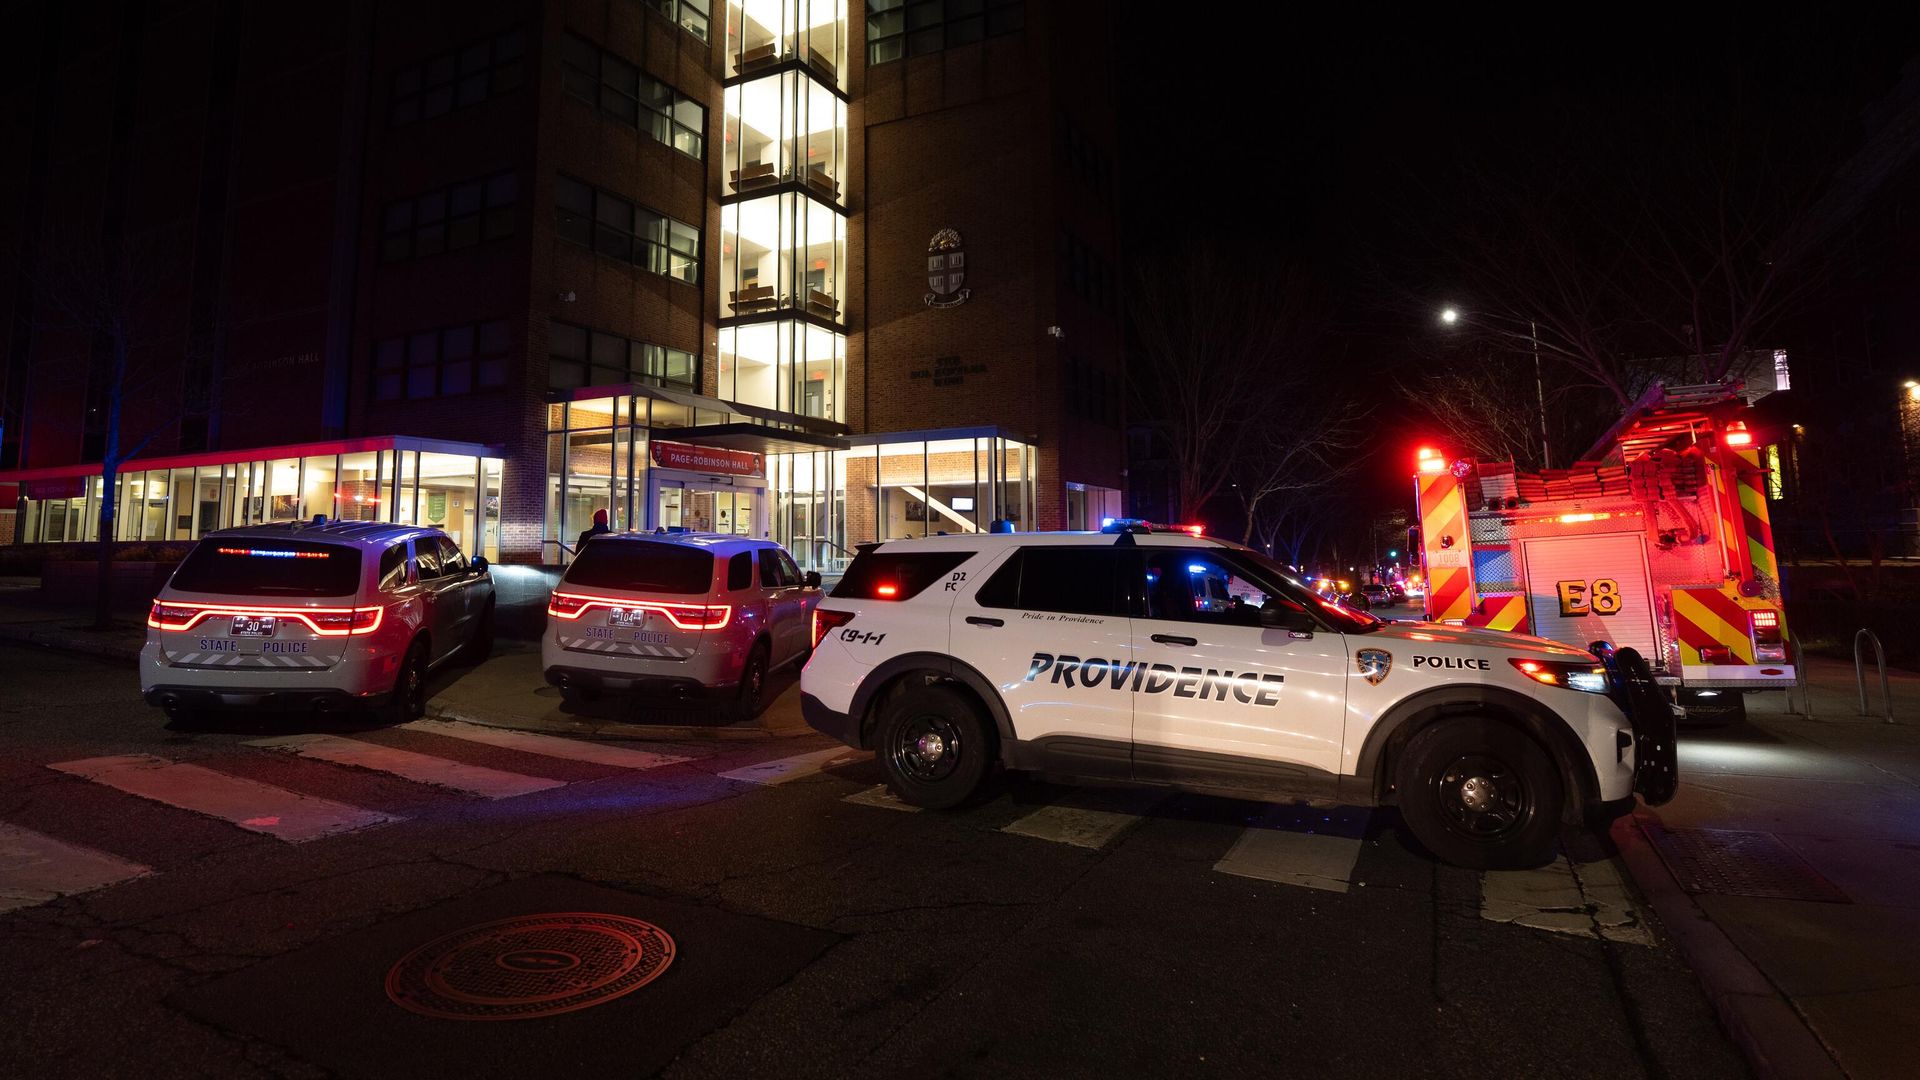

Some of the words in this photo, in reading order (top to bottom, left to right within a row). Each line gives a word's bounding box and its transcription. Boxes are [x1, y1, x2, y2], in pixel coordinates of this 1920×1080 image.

[732, 460, 749, 470] HALL
[952, 572, 967, 581] D2
[945, 582, 957, 592] FC
[1556, 578, 1623, 618] E8
[620, 612, 634, 622] 104
[1021, 612, 1044, 621] Pride
[1059, 615, 1105, 624] Providence
[246, 621, 260, 631] 30
[586, 628, 614, 640] STATE
[634, 631, 668, 643] POLICE
[840, 628, 888, 646] C9-1-1
[200, 639, 237, 652] STATE
[263, 642, 309, 653] POLICE
[1412, 655, 1491, 671] POLICE
[1025, 652, 1285, 707] PROVIDENCE
